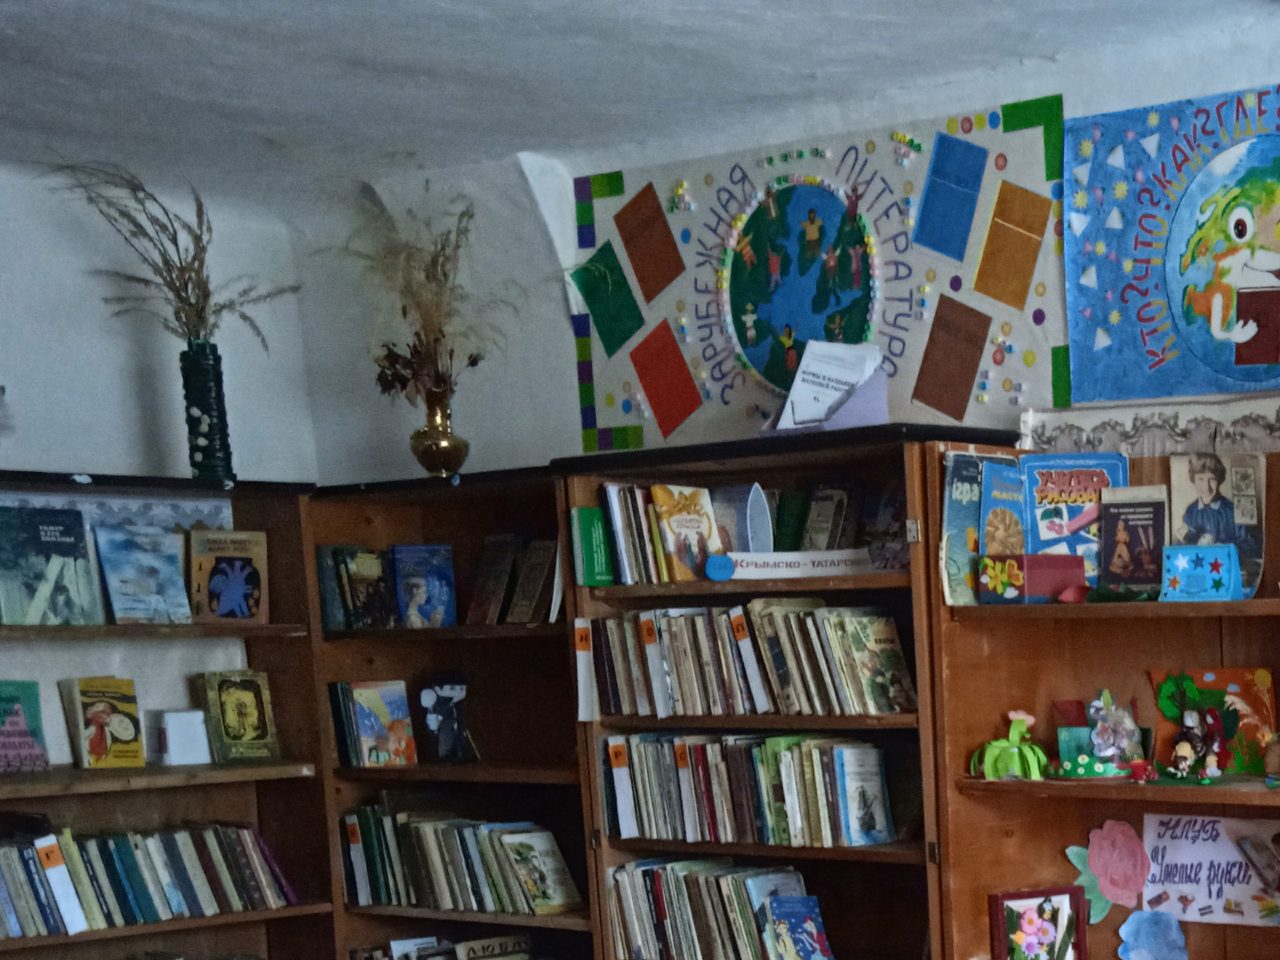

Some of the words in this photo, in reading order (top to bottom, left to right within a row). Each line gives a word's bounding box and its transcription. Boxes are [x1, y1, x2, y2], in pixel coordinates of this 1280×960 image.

[1152, 108, 1220, 202] КАК?
[1132, 188, 1172, 284] ЧТО?
[1120, 284, 1181, 370] КТО?
